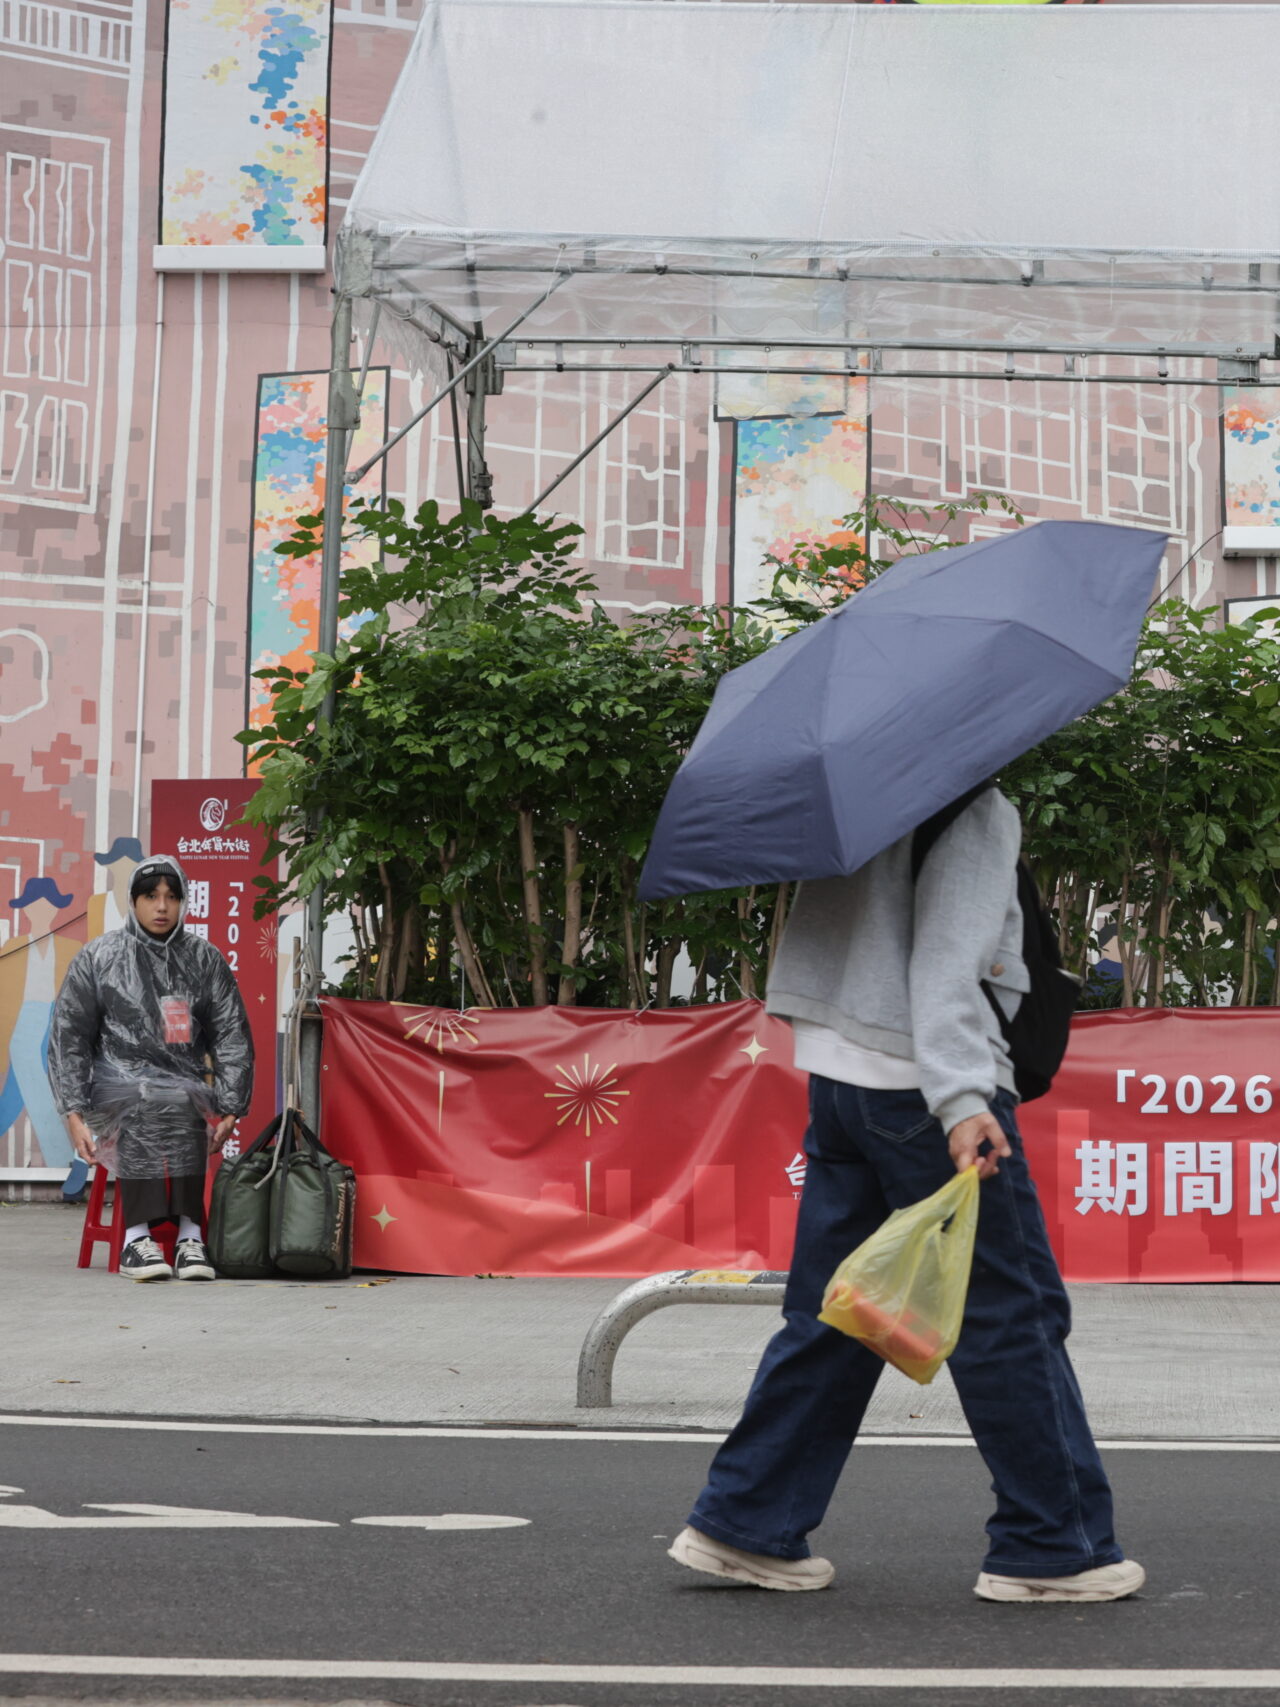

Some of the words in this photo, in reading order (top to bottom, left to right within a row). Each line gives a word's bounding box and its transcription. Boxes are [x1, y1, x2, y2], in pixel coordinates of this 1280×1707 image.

[177, 836, 250, 853] 台北年貨大街
[227, 882, 244, 980] 「202
